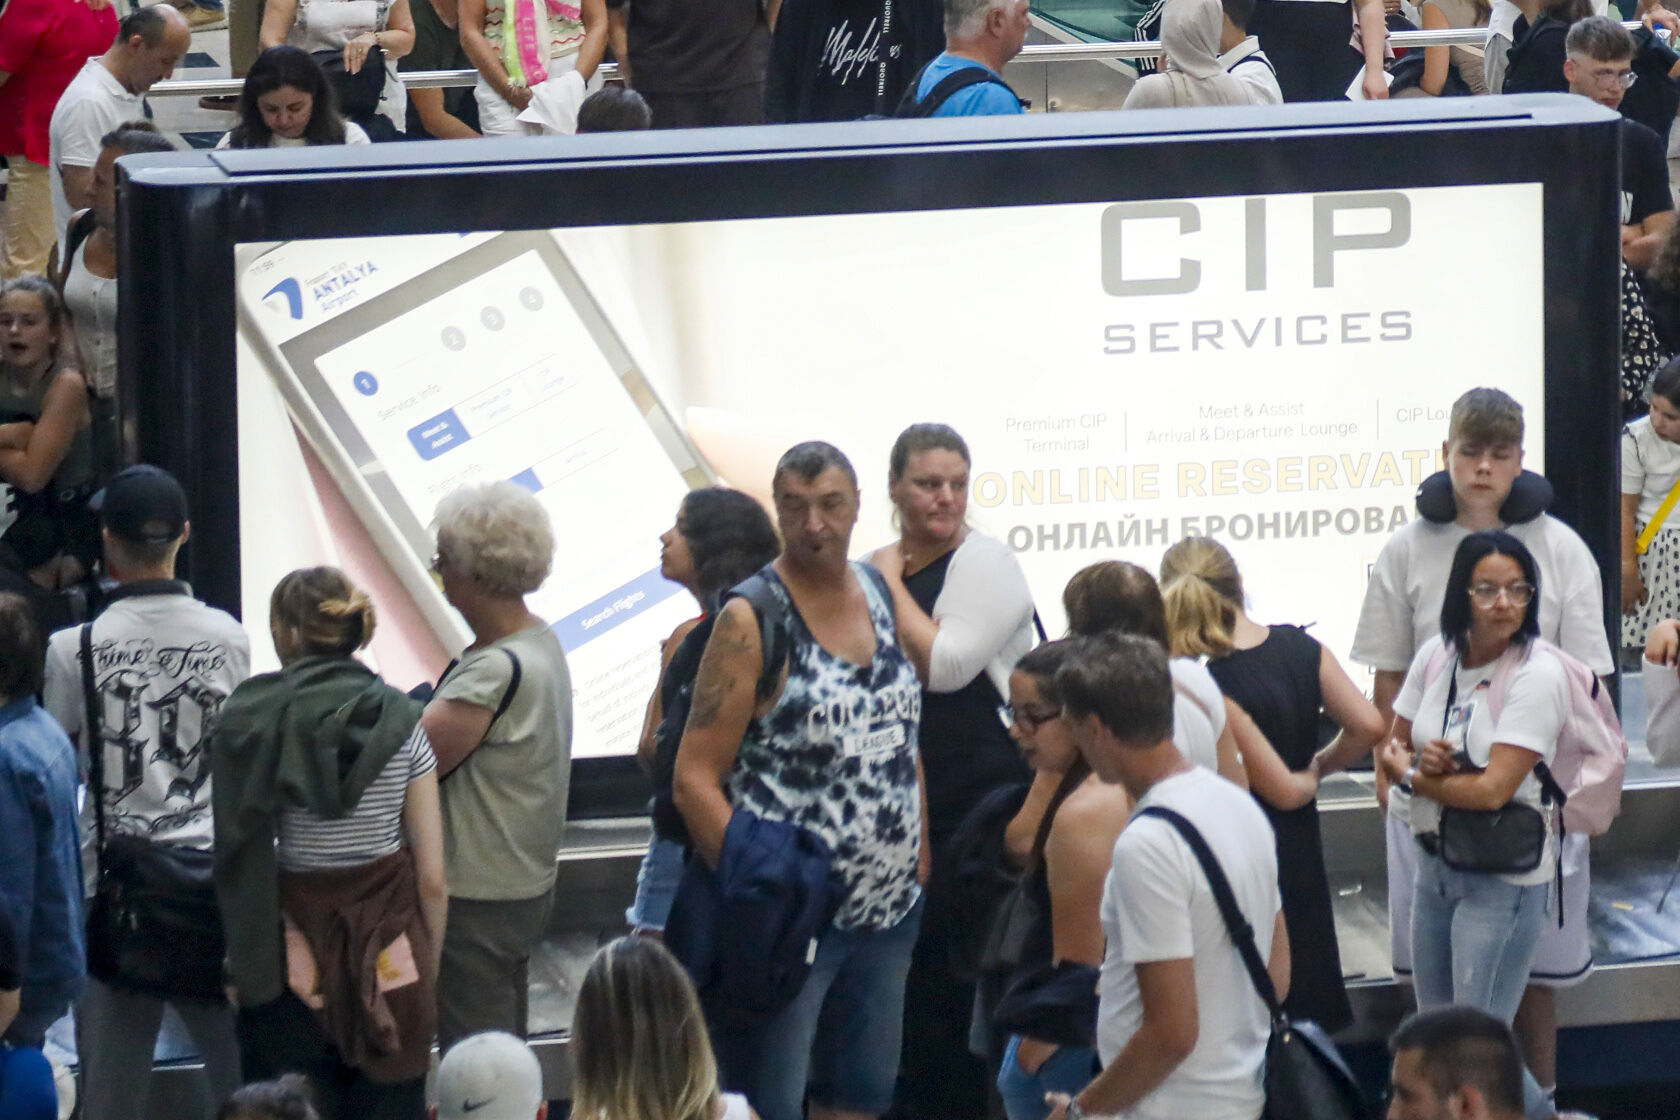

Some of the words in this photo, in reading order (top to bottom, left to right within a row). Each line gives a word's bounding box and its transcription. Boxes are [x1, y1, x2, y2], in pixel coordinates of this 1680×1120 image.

[1100, 191, 1412, 298] CIP
[312, 260, 379, 301] ANTALYA
[1102, 309, 1413, 356] SERVICES
[1005, 415, 1075, 433] Premium
[1080, 413, 1107, 429] CIP
[1199, 404, 1239, 420] Meet
[1259, 401, 1304, 418] Assist
[1396, 406, 1422, 423] CIP
[1024, 436, 1090, 453] Terminal
[1146, 427, 1196, 446] Arrival
[1214, 423, 1294, 446] Departure
[1300, 419, 1358, 441] Lounge
[973, 462, 1162, 509] ONLINE
[1007, 512, 1169, 555] ОНЛАЙН
[1181, 504, 1410, 543] БРОНИРОВА
